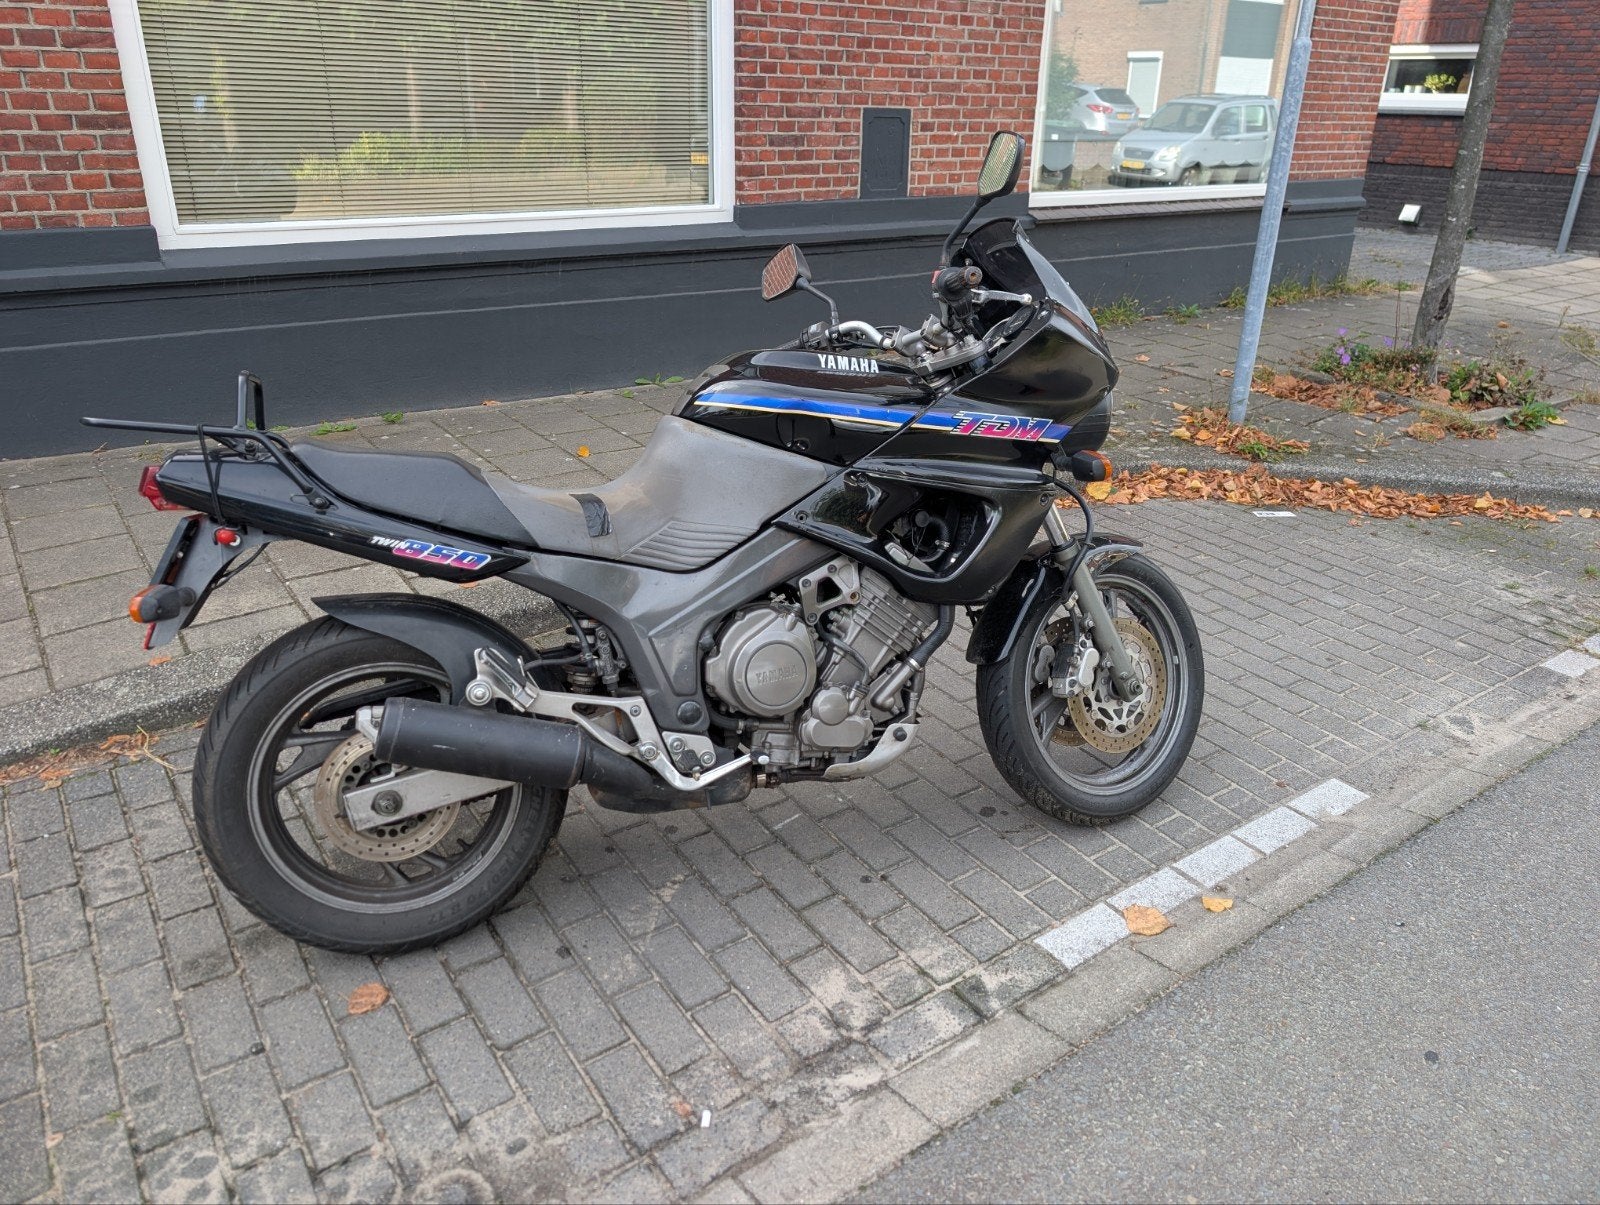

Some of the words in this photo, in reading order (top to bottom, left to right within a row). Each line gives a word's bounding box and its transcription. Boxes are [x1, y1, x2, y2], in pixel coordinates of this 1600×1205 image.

[817, 353, 879, 374] YAMAHA
[950, 411, 1053, 441] TDM
[371, 536, 410, 550] TWIN
[393, 539, 491, 570] 850
[755, 664, 799, 684] YAMAHA
